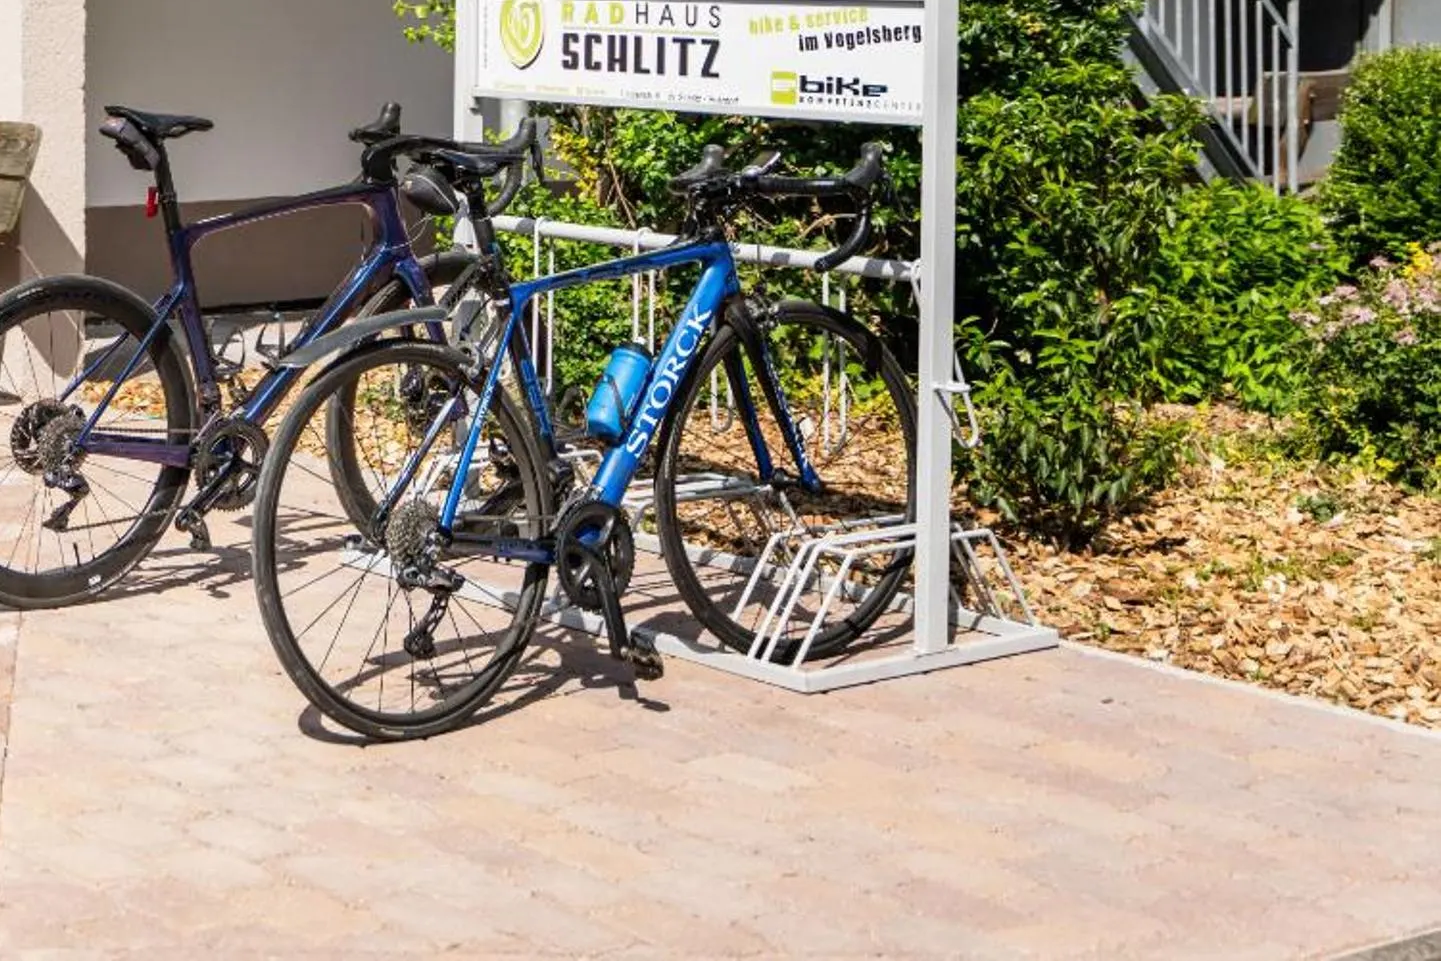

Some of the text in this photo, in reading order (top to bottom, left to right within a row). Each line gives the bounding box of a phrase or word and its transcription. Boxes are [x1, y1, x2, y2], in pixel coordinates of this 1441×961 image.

[562, 1, 722, 28] RADHAUS
[749, 7, 869, 34] bike & service
[798, 25, 922, 52] im Vogelsberg
[562, 33, 720, 78] SCHLITZ
[626, 303, 712, 458] STORCK
